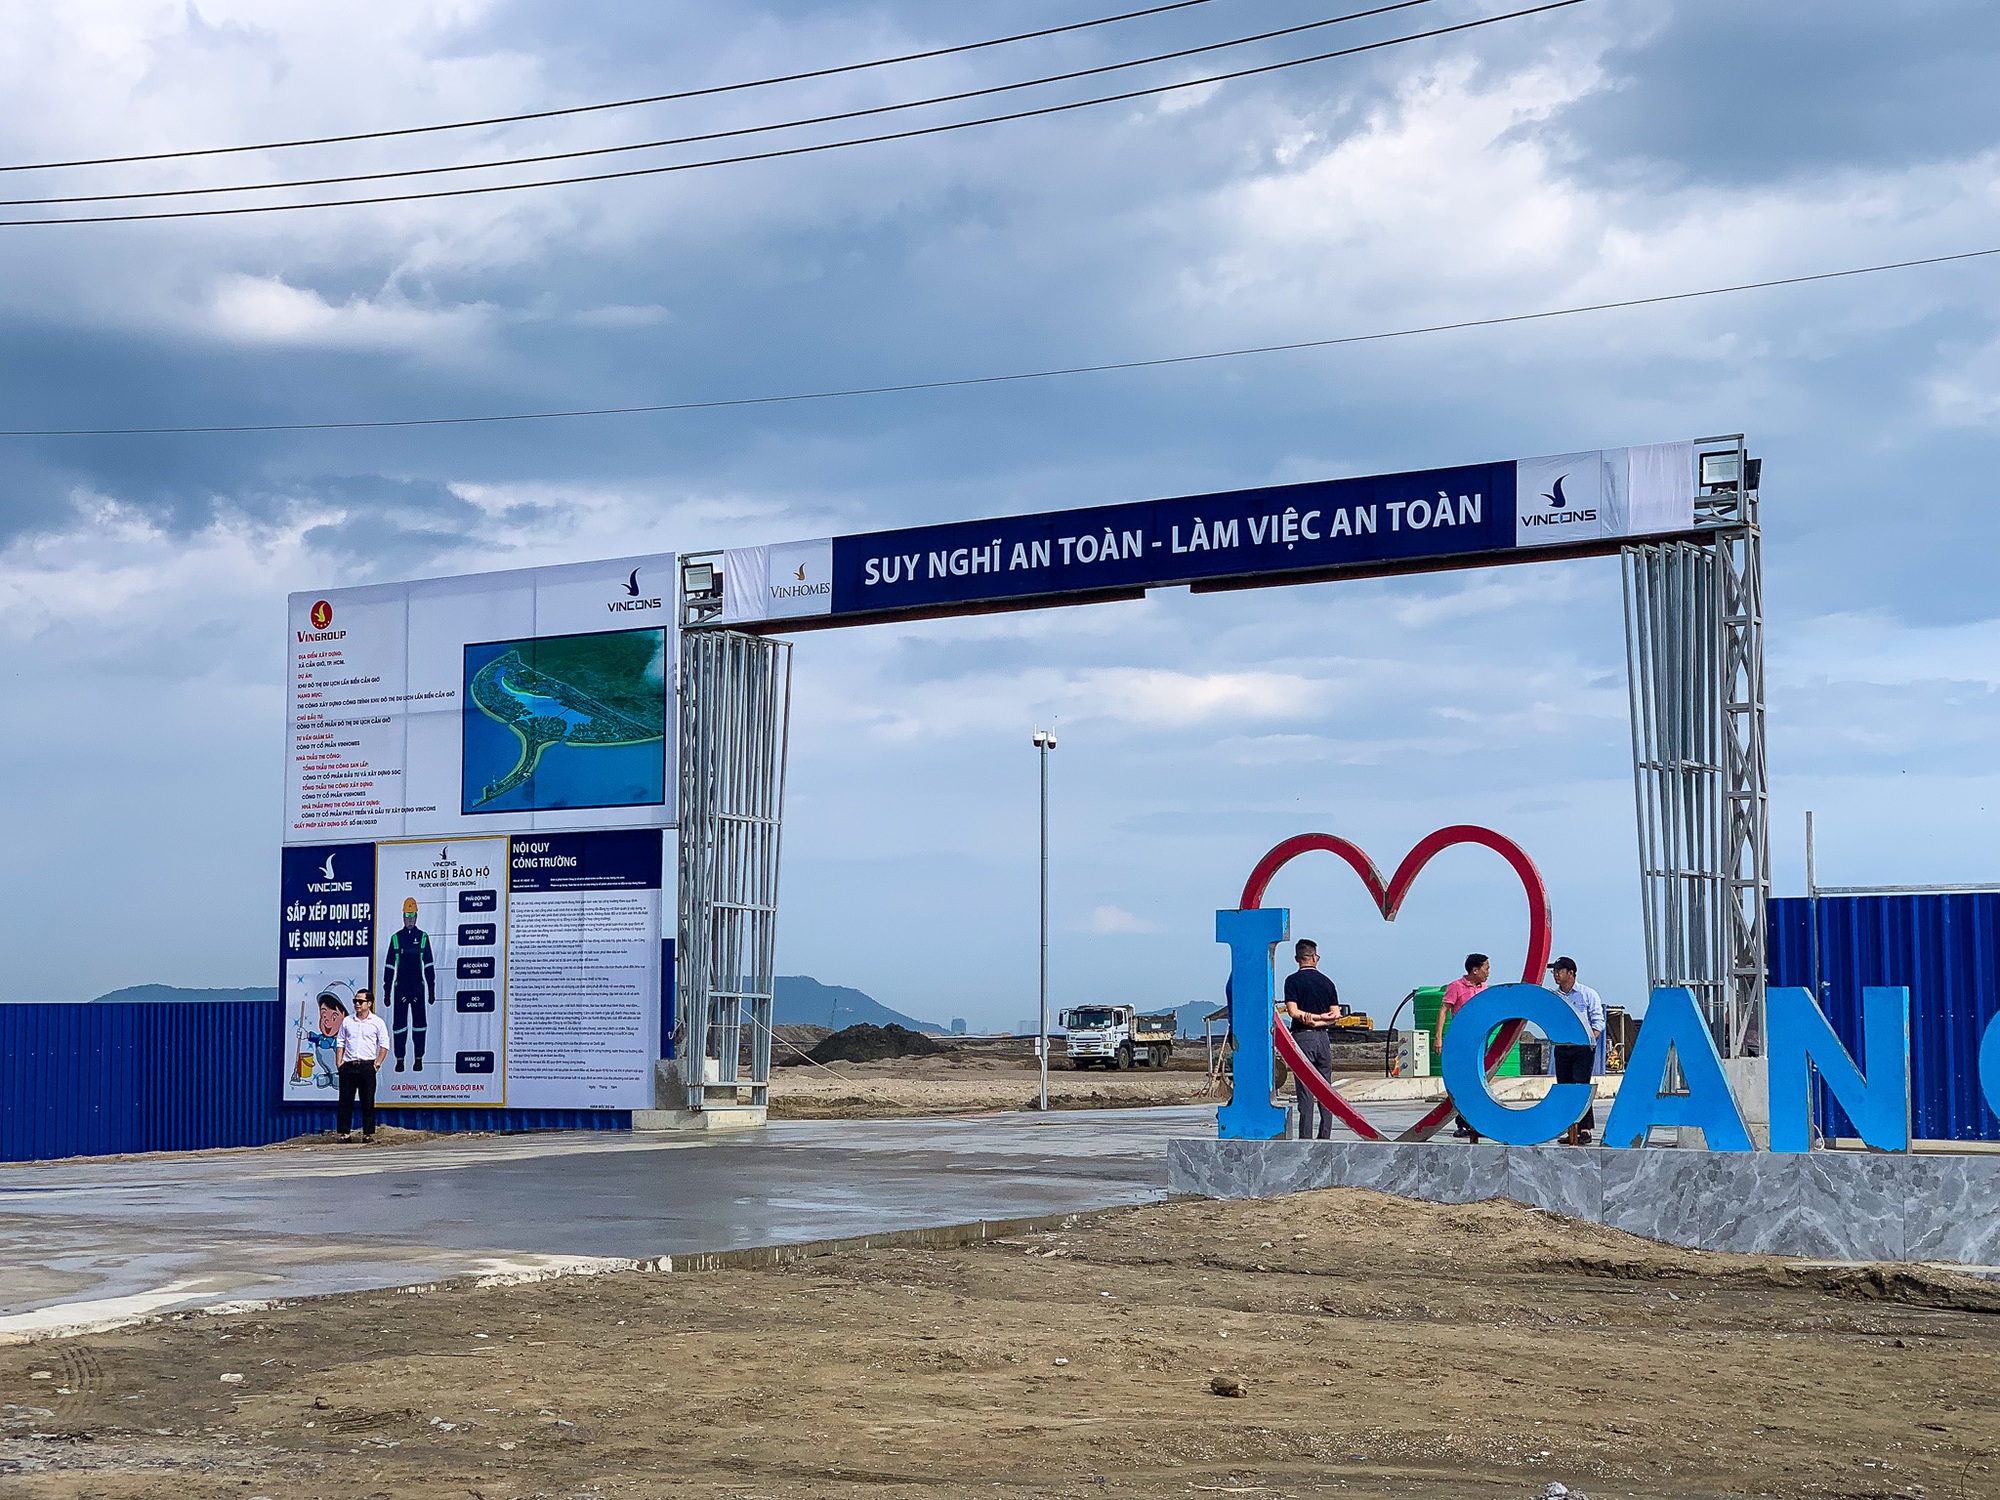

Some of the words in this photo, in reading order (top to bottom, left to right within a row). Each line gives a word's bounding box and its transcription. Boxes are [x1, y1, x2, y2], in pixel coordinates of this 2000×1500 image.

[1520, 508, 1598, 527] VINCONS
[865, 554, 921, 585] SUY
[928, 538, 1002, 579] NGHĨ
[1009, 540, 1050, 571] AN
[1058, 527, 1142, 565] TOÀN
[1171, 517, 1239, 554] LÀM
[1248, 506, 1320, 551] VIỆC
[1330, 504, 1377, 538] AN
[1386, 491, 1482, 532] TOÀN
[770, 582, 831, 599] VINHOMES
[607, 598, 662, 613] VINCONS
[297, 630, 346, 643] VINGROUP
[512, 841, 529, 856] NỘI
[530, 842, 550, 854] QUY
[512, 857, 538, 869] CÔNG
[539, 855, 577, 868] TRƯỜNG
[405, 870, 437, 880] TRANG
[440, 869, 449, 880] BỊ
[452, 866, 473, 878] BẢO
[476, 866, 490, 879] HỘ
[307, 881, 352, 893] VINCONS
[287, 900, 306, 922] SẮP
[308, 900, 327, 921] XẾP
[330, 904, 349, 923] DỌN
[351, 903, 371, 923] DẸP,
[288, 929, 300, 951] VỆ
[303, 931, 326, 948] SINH
[328, 930, 354, 950] SẠCH
[356, 926, 368, 946] SẼ
[1216, 907, 1291, 1140] I
[1442, 982, 1909, 1155] CAN
[472, 1084, 484, 1092] BẠN
